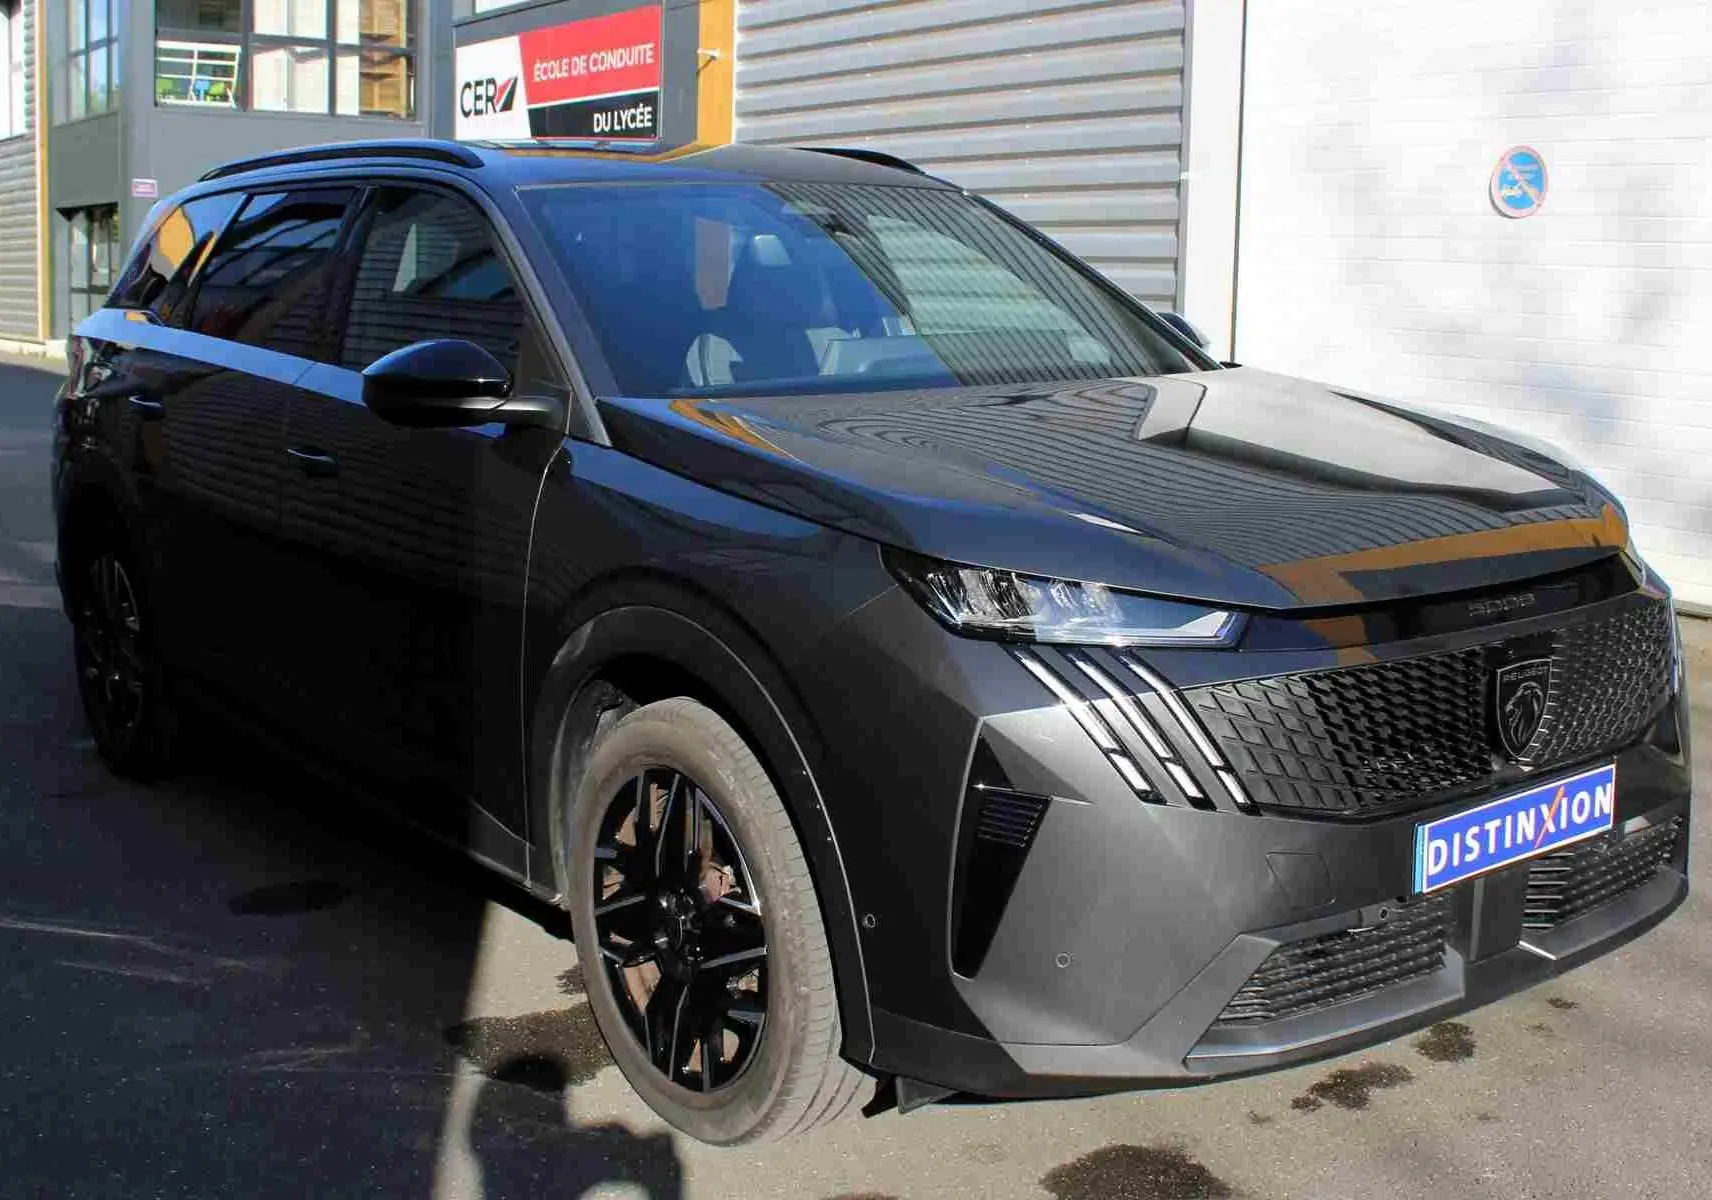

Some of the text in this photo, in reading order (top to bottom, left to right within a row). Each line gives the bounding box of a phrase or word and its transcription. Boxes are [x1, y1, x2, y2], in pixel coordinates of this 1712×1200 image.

[533, 42, 655, 82] ÉCOLE DE CONDUITE
[460, 77, 497, 118] CER
[593, 102, 653, 133] DU LYCÉE
[1427, 783, 1612, 876] DISTINXION
